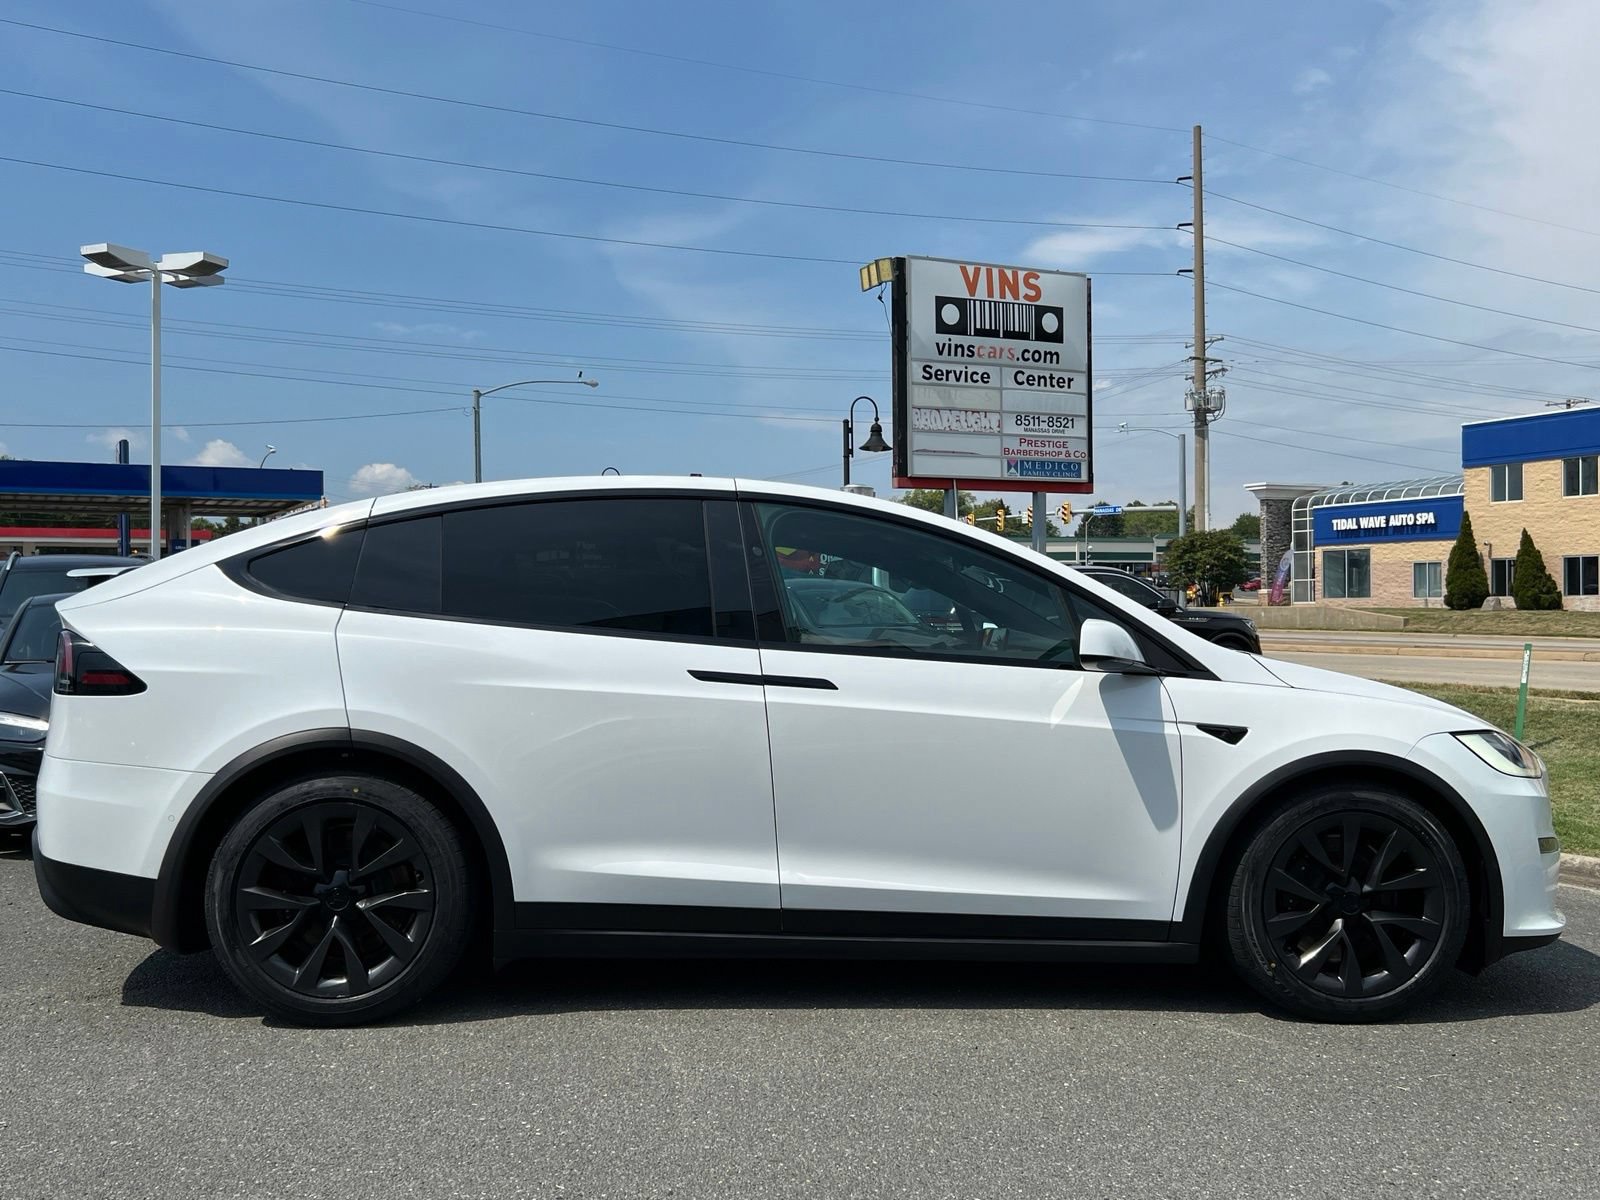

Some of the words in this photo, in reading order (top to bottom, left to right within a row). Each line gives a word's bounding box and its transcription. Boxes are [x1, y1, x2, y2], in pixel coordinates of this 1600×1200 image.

[960, 265, 1042, 302] VINS
[936, 338, 1060, 364] vinscars.com
[922, 365, 991, 384] Service
[1013, 370, 1074, 389] Center
[1015, 415, 1074, 429] 8511-8521
[1019, 438, 1069, 449] PRESTIGE
[1003, 447, 1063, 457] BARBERSHOP
[1064, 450, 1071, 458] &
[1023, 461, 1079, 471] MEDICO
[1332, 517, 1358, 531] TIDAL
[1359, 515, 1387, 529] WAVE
[1388, 513, 1415, 527] AUTO
[1416, 511, 1435, 525] SPA
